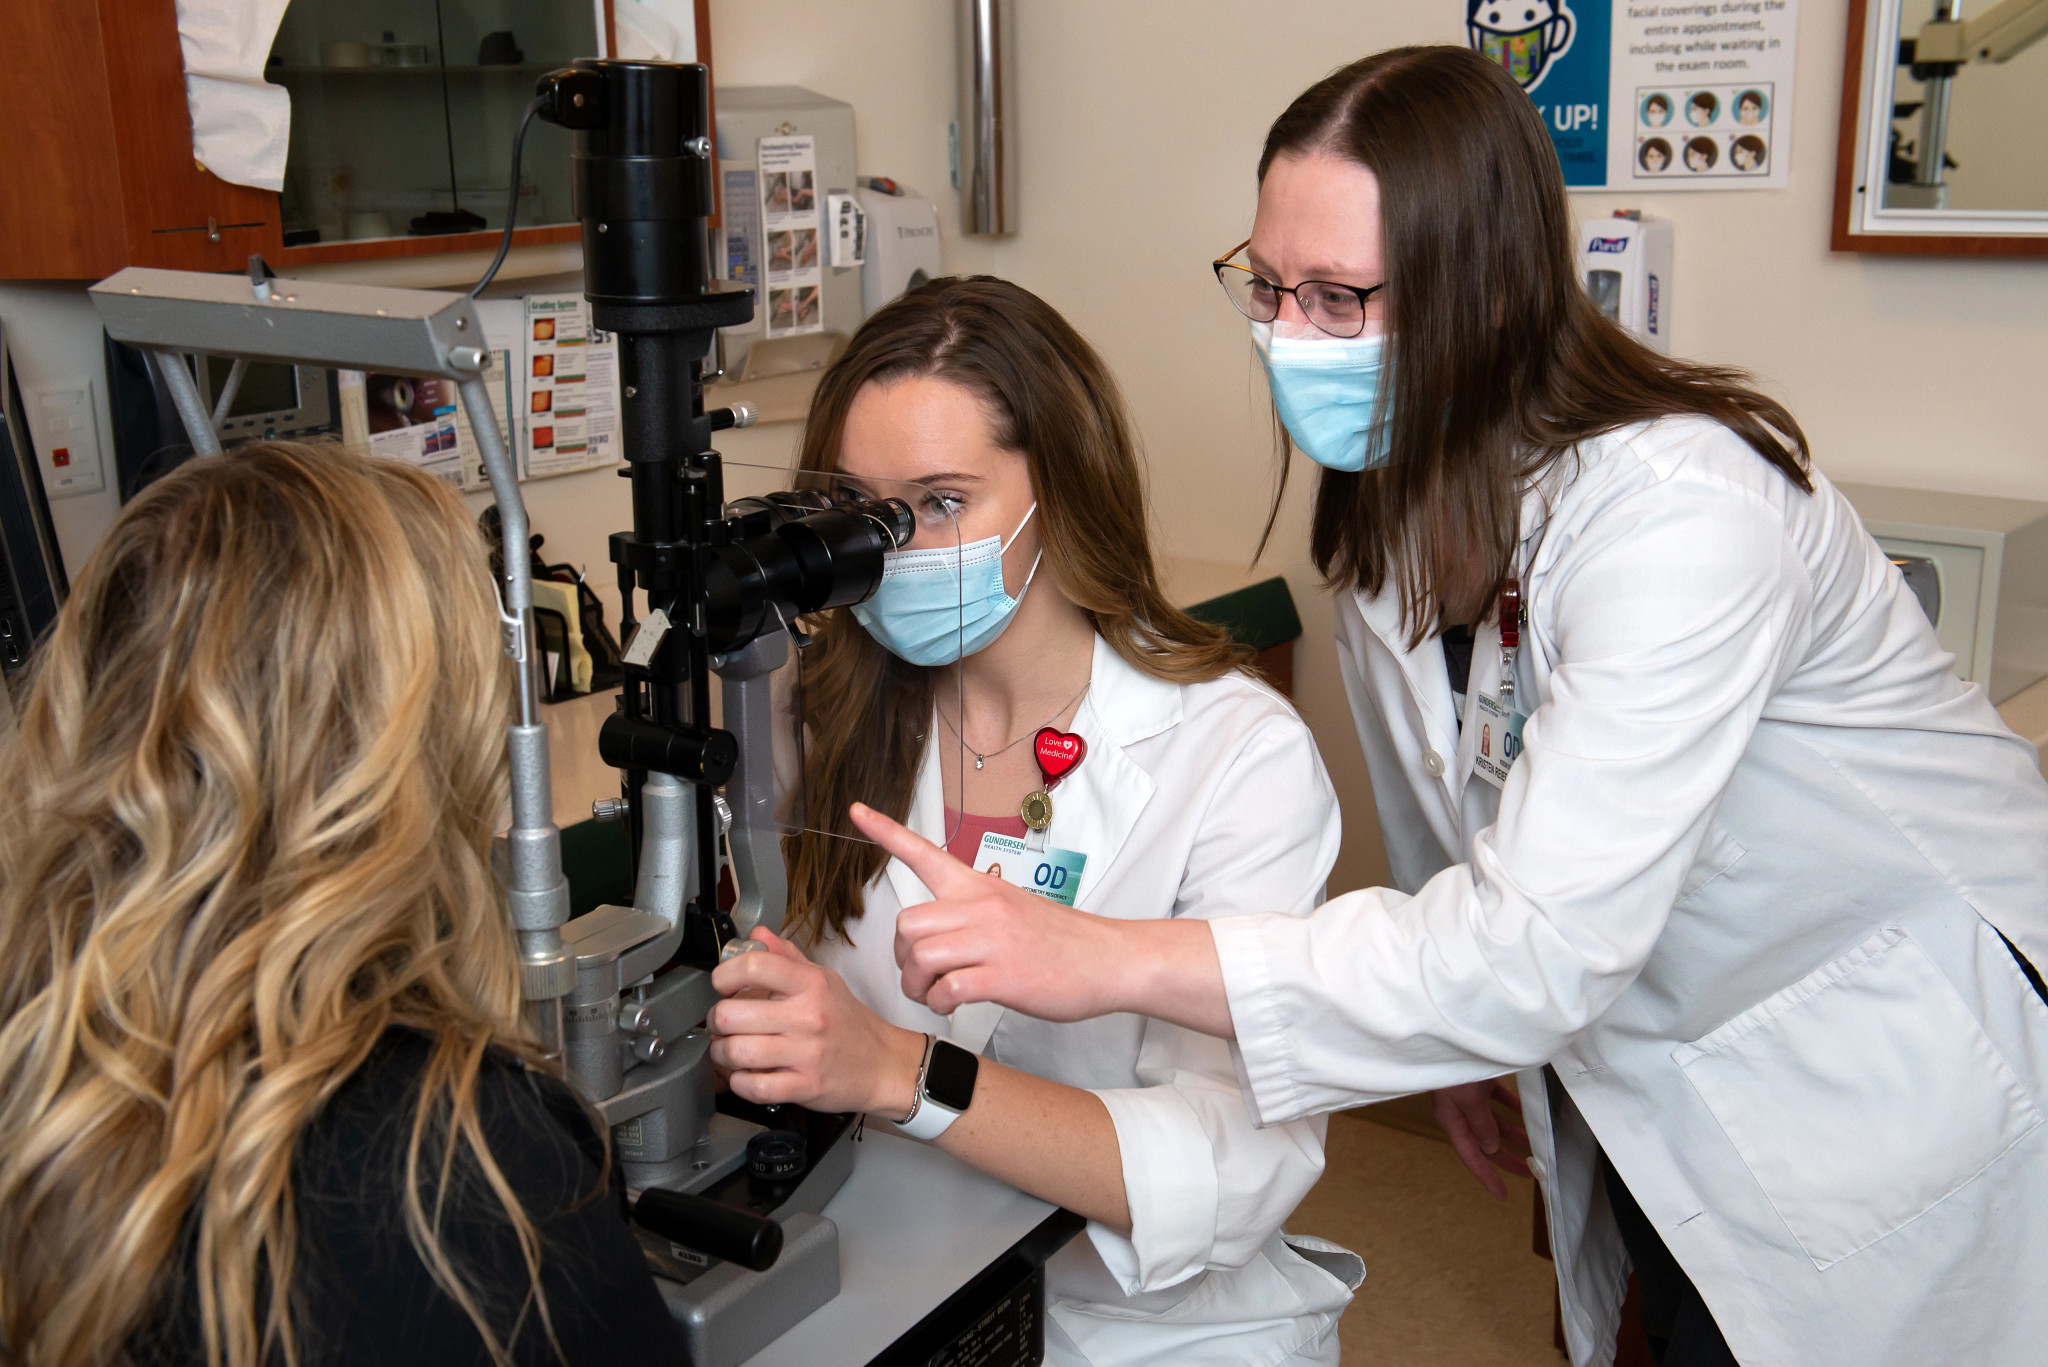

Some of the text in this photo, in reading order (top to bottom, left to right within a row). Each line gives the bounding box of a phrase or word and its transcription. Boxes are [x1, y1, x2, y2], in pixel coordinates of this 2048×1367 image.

[1628, 0, 1786, 18] facial coverings during the
[1644, 20, 1765, 36] entire appointment,
[1629, 37, 1781, 55] including while waiting in
[1655, 58, 1750, 72] the exam room.
[1554, 103, 1598, 131] UP!
[531, 300, 578, 311] Grading System
[1044, 737, 1062, 747] Love
[1503, 731, 1520, 761] OD
[1039, 747, 1074, 760] Medicine
[1475, 755, 1495, 775] KRISTEN
[983, 843, 1022, 856] HEALTH SYSTEM
[984, 834, 1027, 851] GUNDERSEN
[1034, 862, 1068, 890] OD
[1045, 891, 1068, 901] RESIDENCY
[776, 1162, 795, 1173] USA
